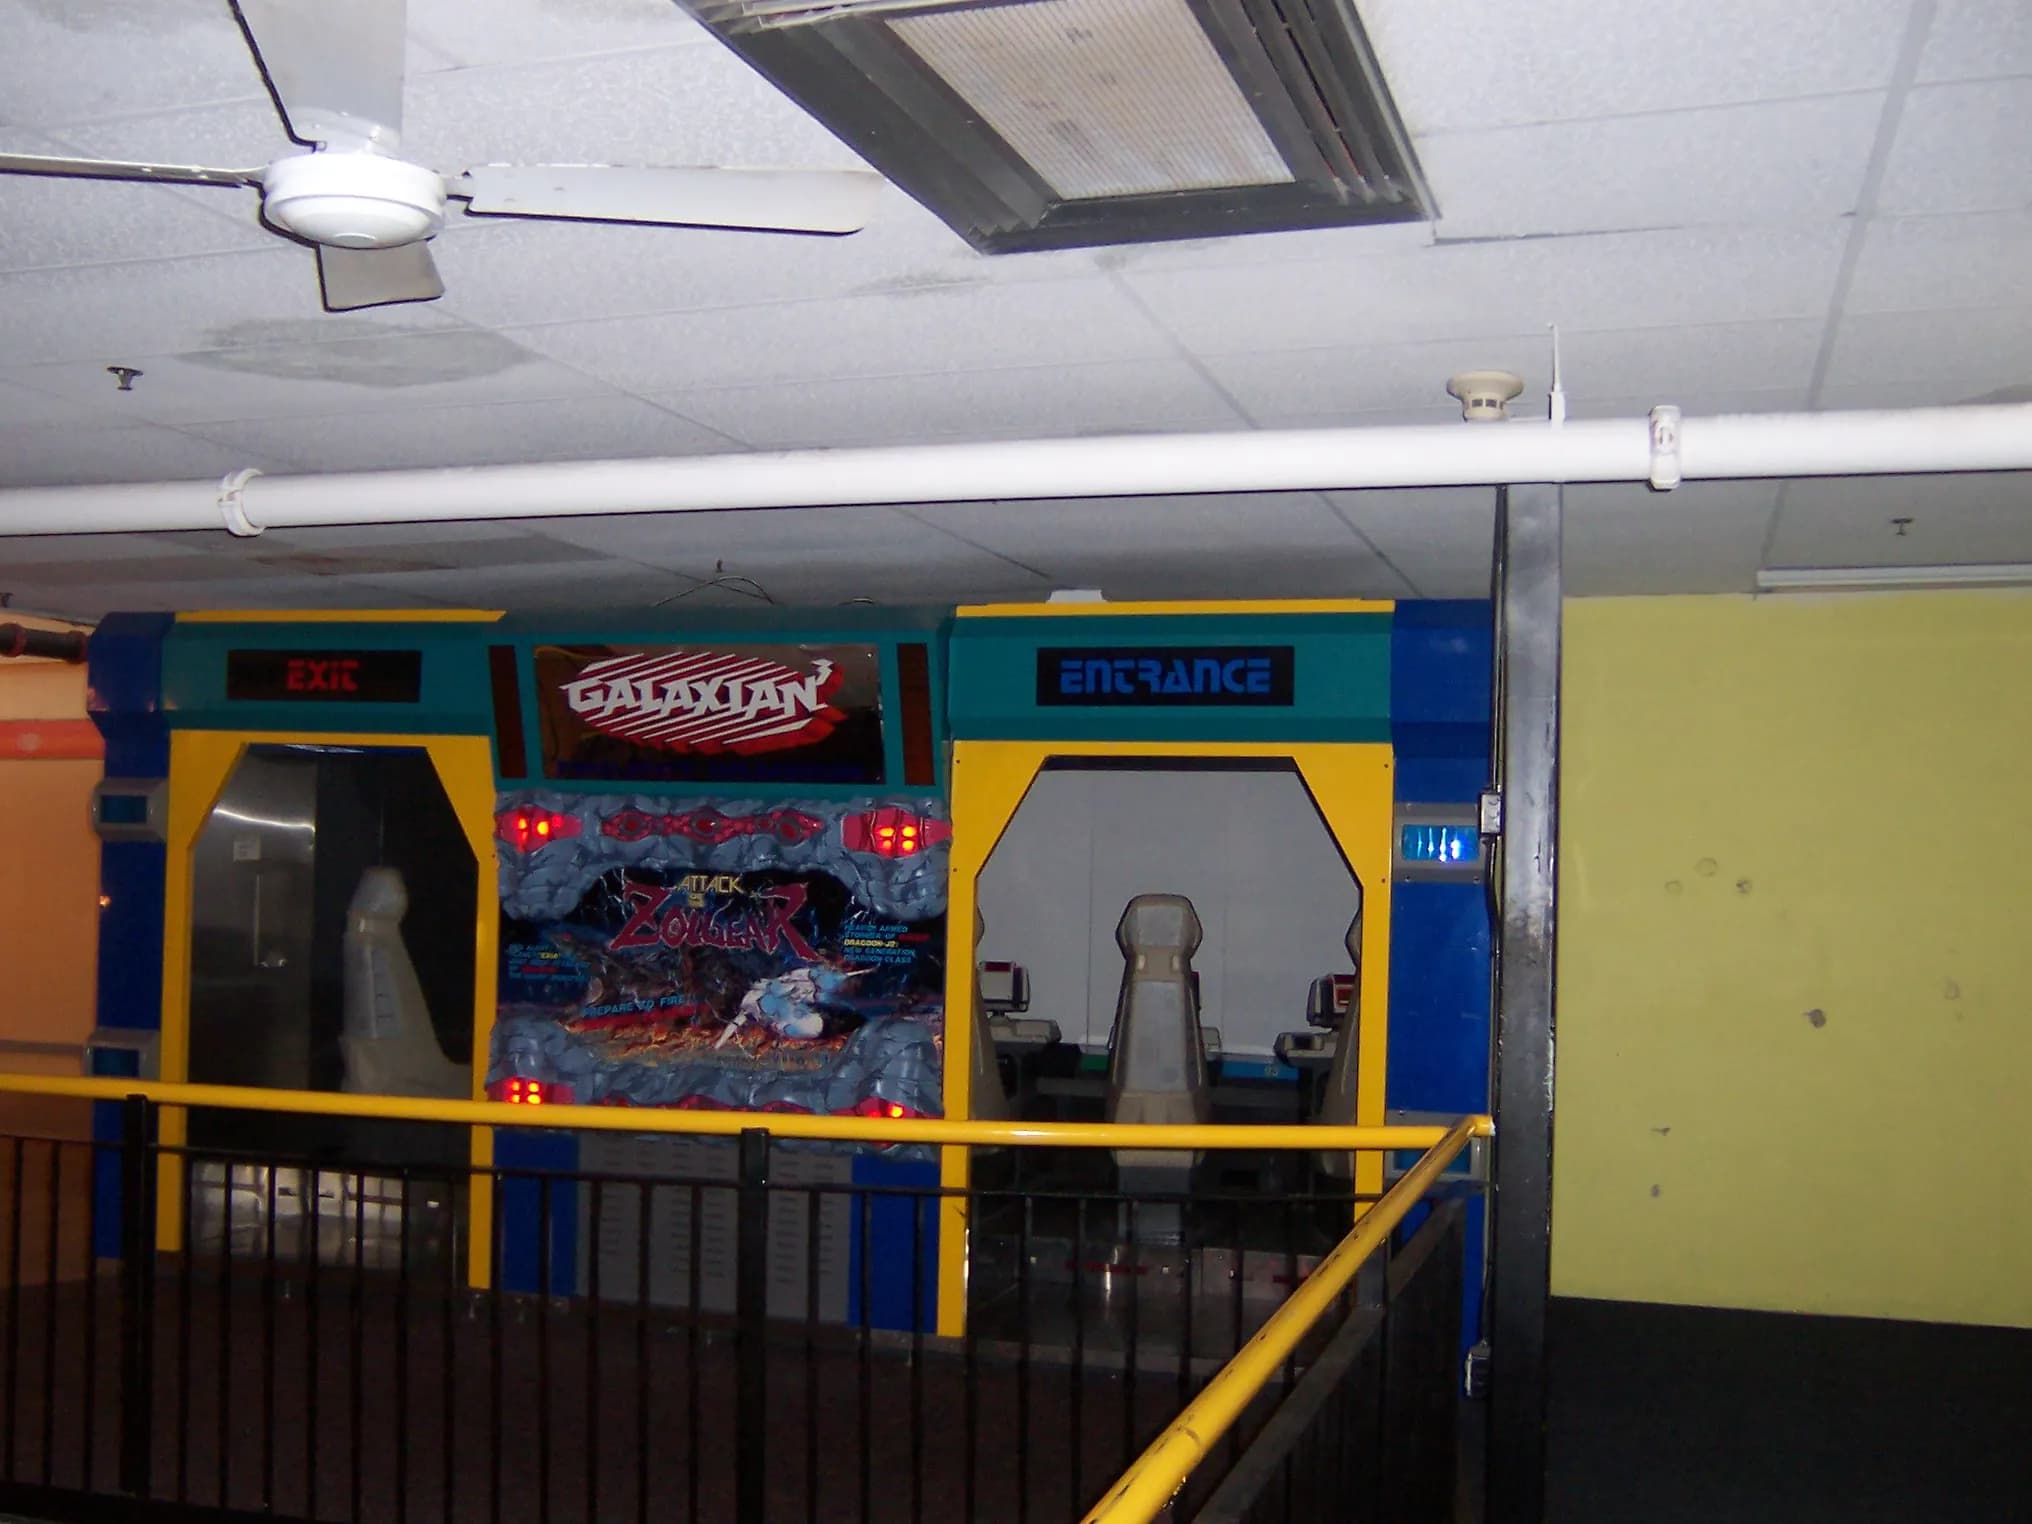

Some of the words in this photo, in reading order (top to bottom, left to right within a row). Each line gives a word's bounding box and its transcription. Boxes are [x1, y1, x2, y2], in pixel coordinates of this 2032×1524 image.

[286, 659, 360, 691] EXIT
[1060, 658, 1272, 695] ENTRANCE
[677, 874, 743, 893] ATTACK
[608, 880, 823, 962] ZOLGEAR
[582, 1001, 634, 1017] PREPARE
